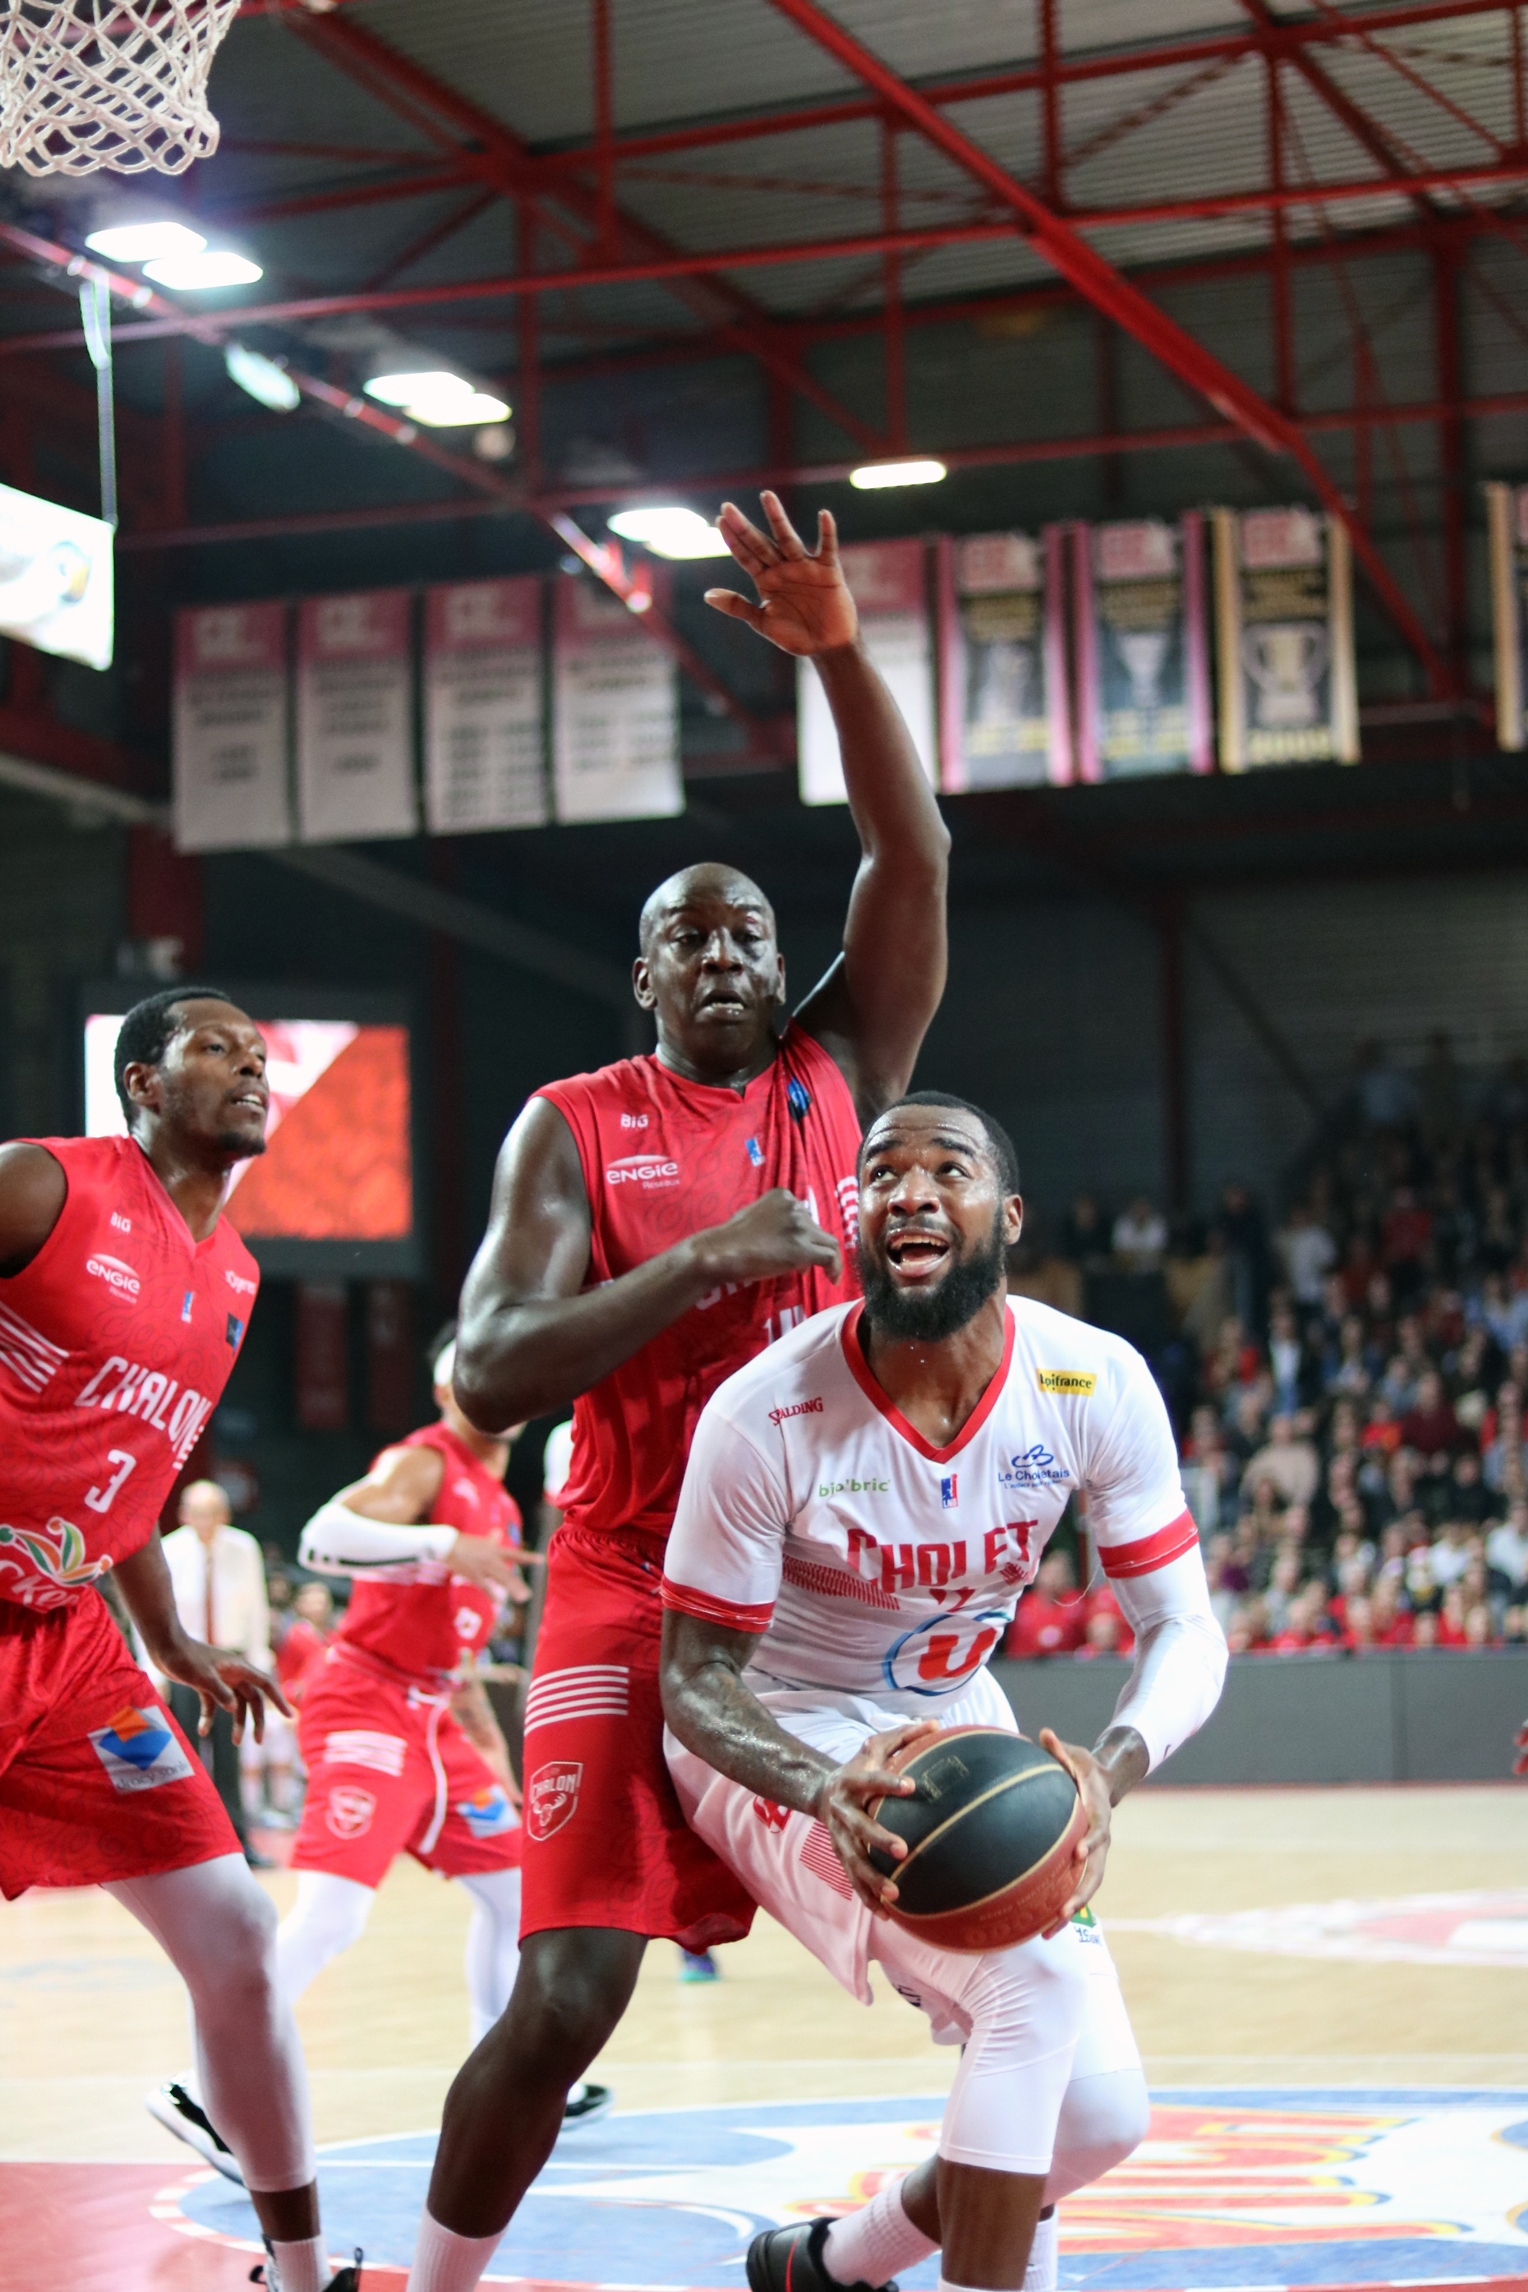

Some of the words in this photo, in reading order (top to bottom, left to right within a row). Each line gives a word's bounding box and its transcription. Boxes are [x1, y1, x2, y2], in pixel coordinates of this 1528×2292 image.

[74, 1355, 212, 1460] CHALON
[84, 1449, 137, 1513] 3
[998, 1472, 1013, 1483] Le
[1015, 1468, 1070, 1481] Choletais
[847, 1520, 1038, 1594] CHOLET
[917, 1627, 997, 1681] U
